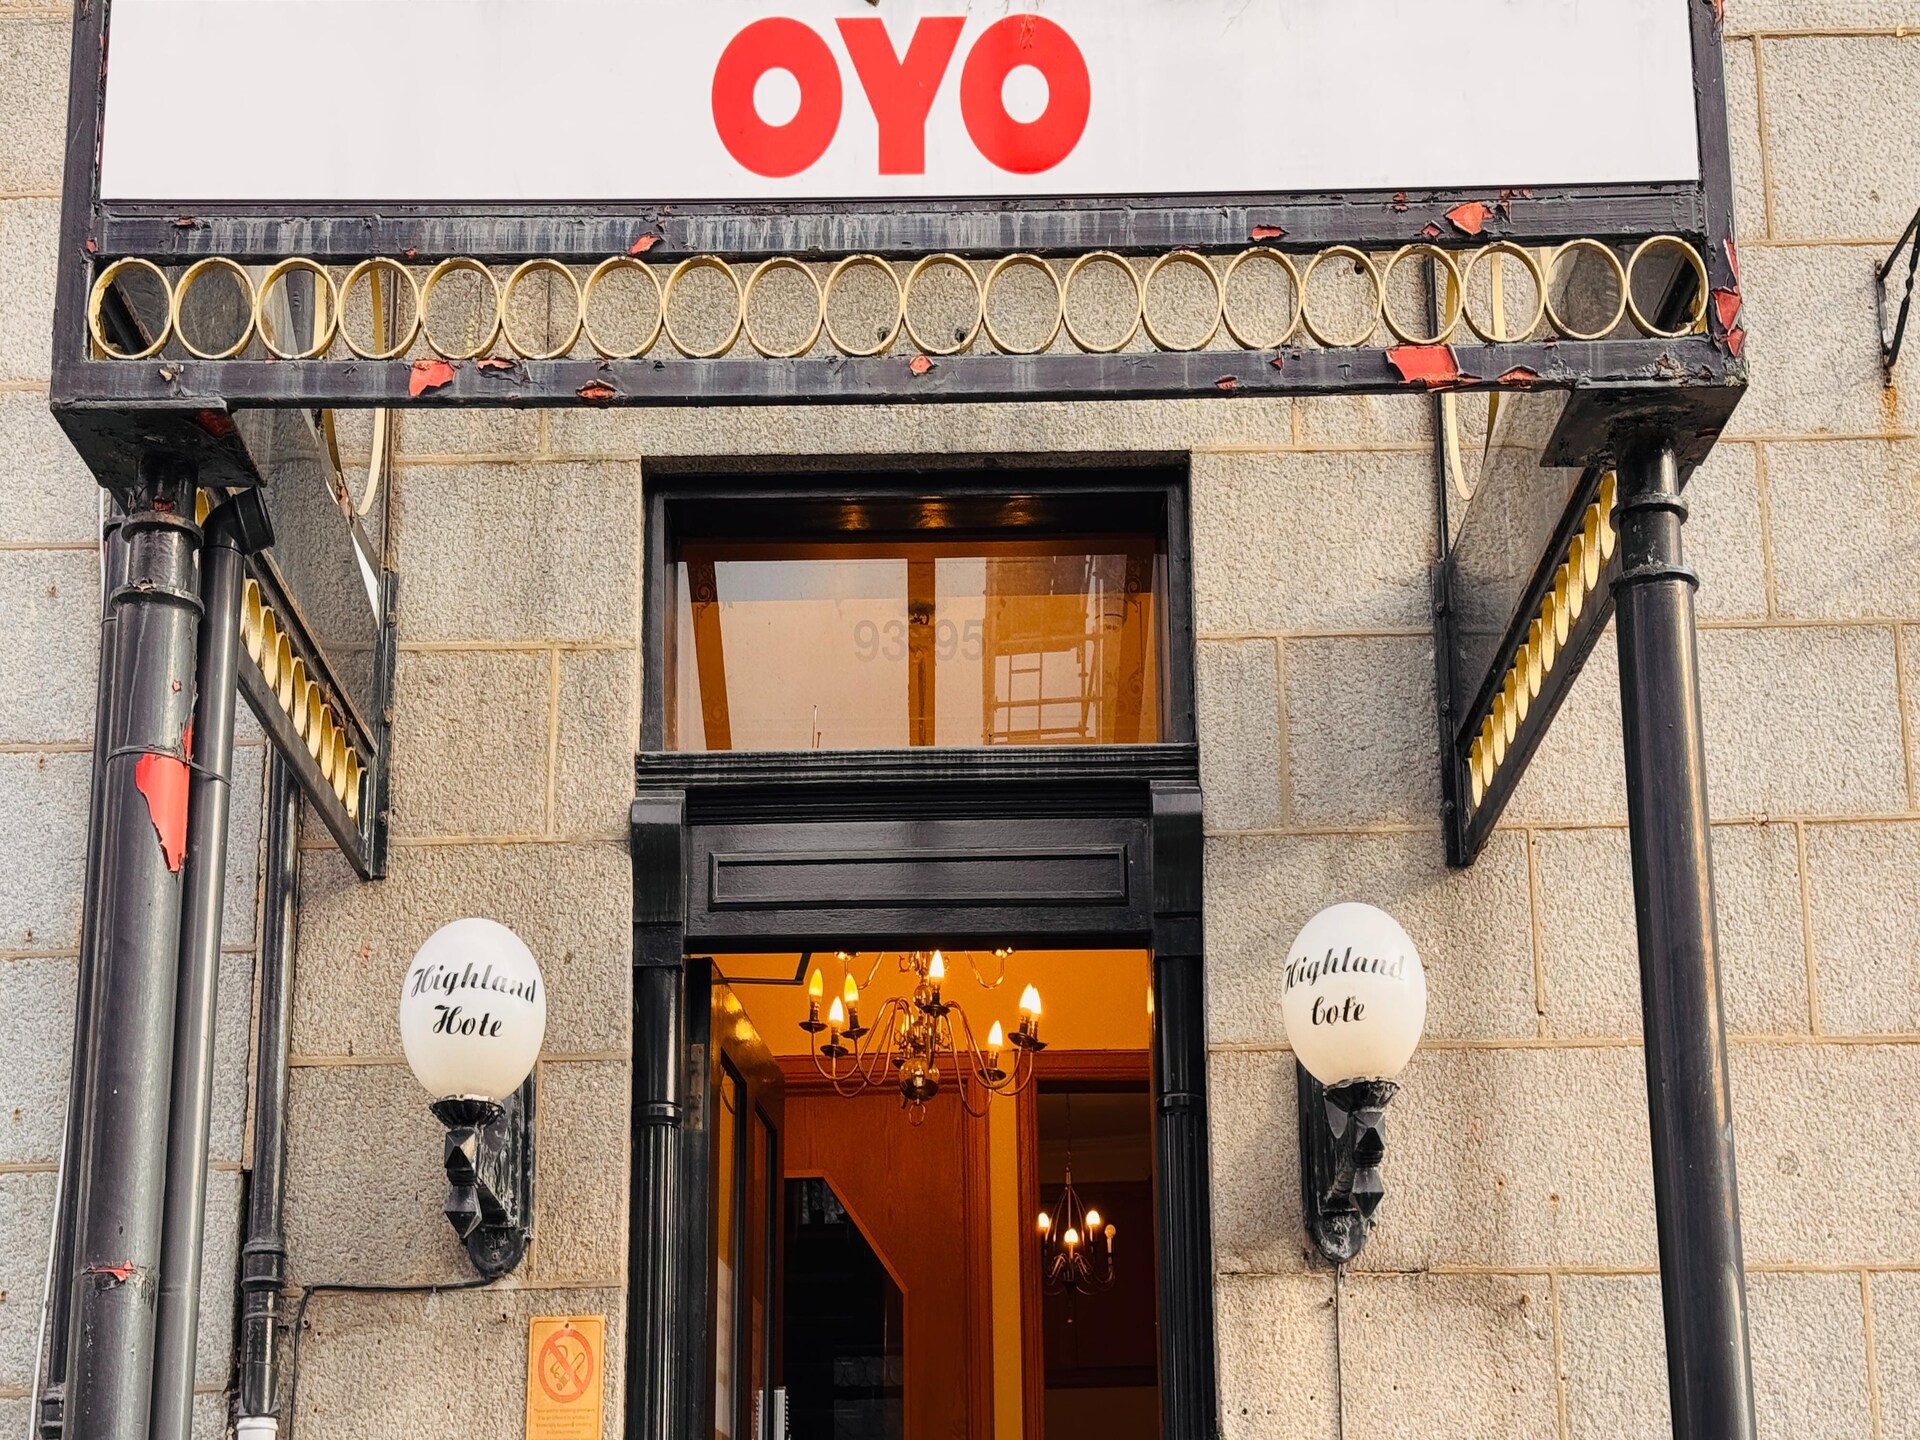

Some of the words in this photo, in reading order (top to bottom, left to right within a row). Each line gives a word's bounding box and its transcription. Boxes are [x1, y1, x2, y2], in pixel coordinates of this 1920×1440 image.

[711, 13, 1091, 178] OYO
[410, 962, 537, 1003] Highland
[1285, 946, 1406, 995] Highland
[432, 1004, 504, 1038] Hote
